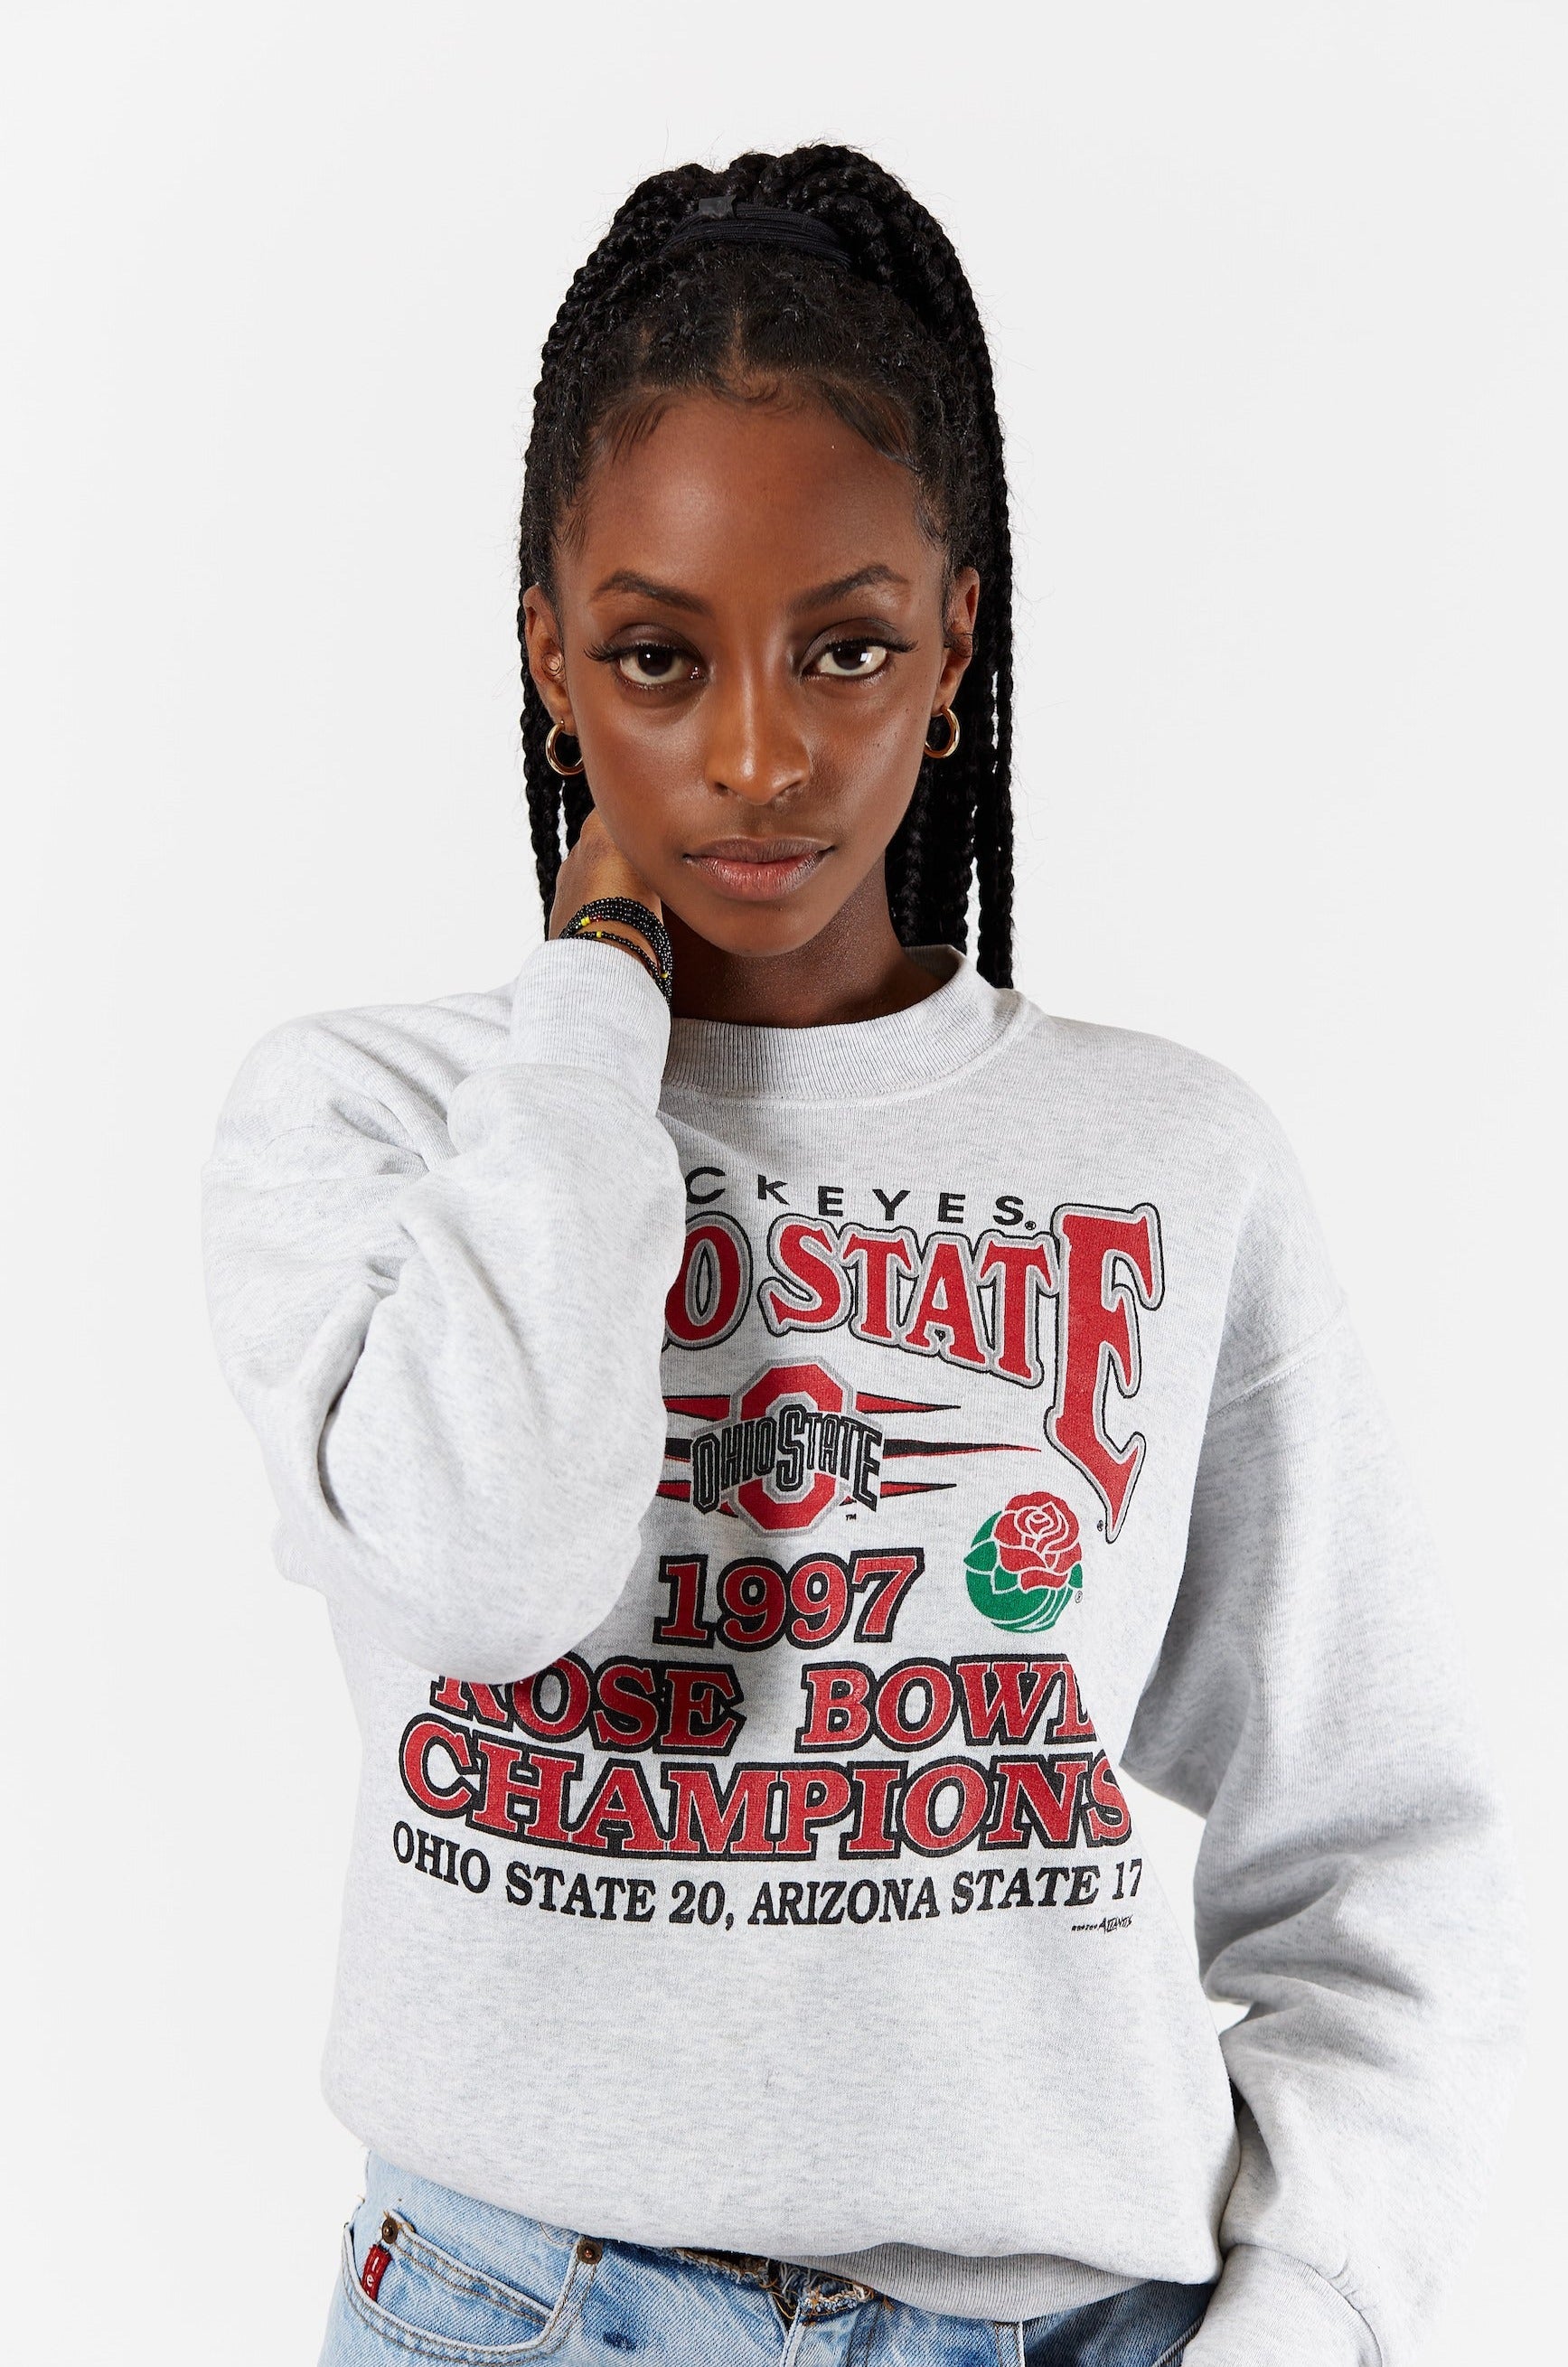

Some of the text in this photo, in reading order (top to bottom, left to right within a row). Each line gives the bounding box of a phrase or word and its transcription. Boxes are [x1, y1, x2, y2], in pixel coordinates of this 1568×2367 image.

[684, 1166, 1024, 1226] CKEYES
[756, 1203, 1164, 1543] STATE
[652, 1547, 925, 1652] 1997
[793, 1652, 1097, 1755] BOWL
[399, 1712, 1131, 1861] CHAMPIONS
[392, 1819, 1142, 1931] OHIO STATE 20, ARIZONA STATE 17
